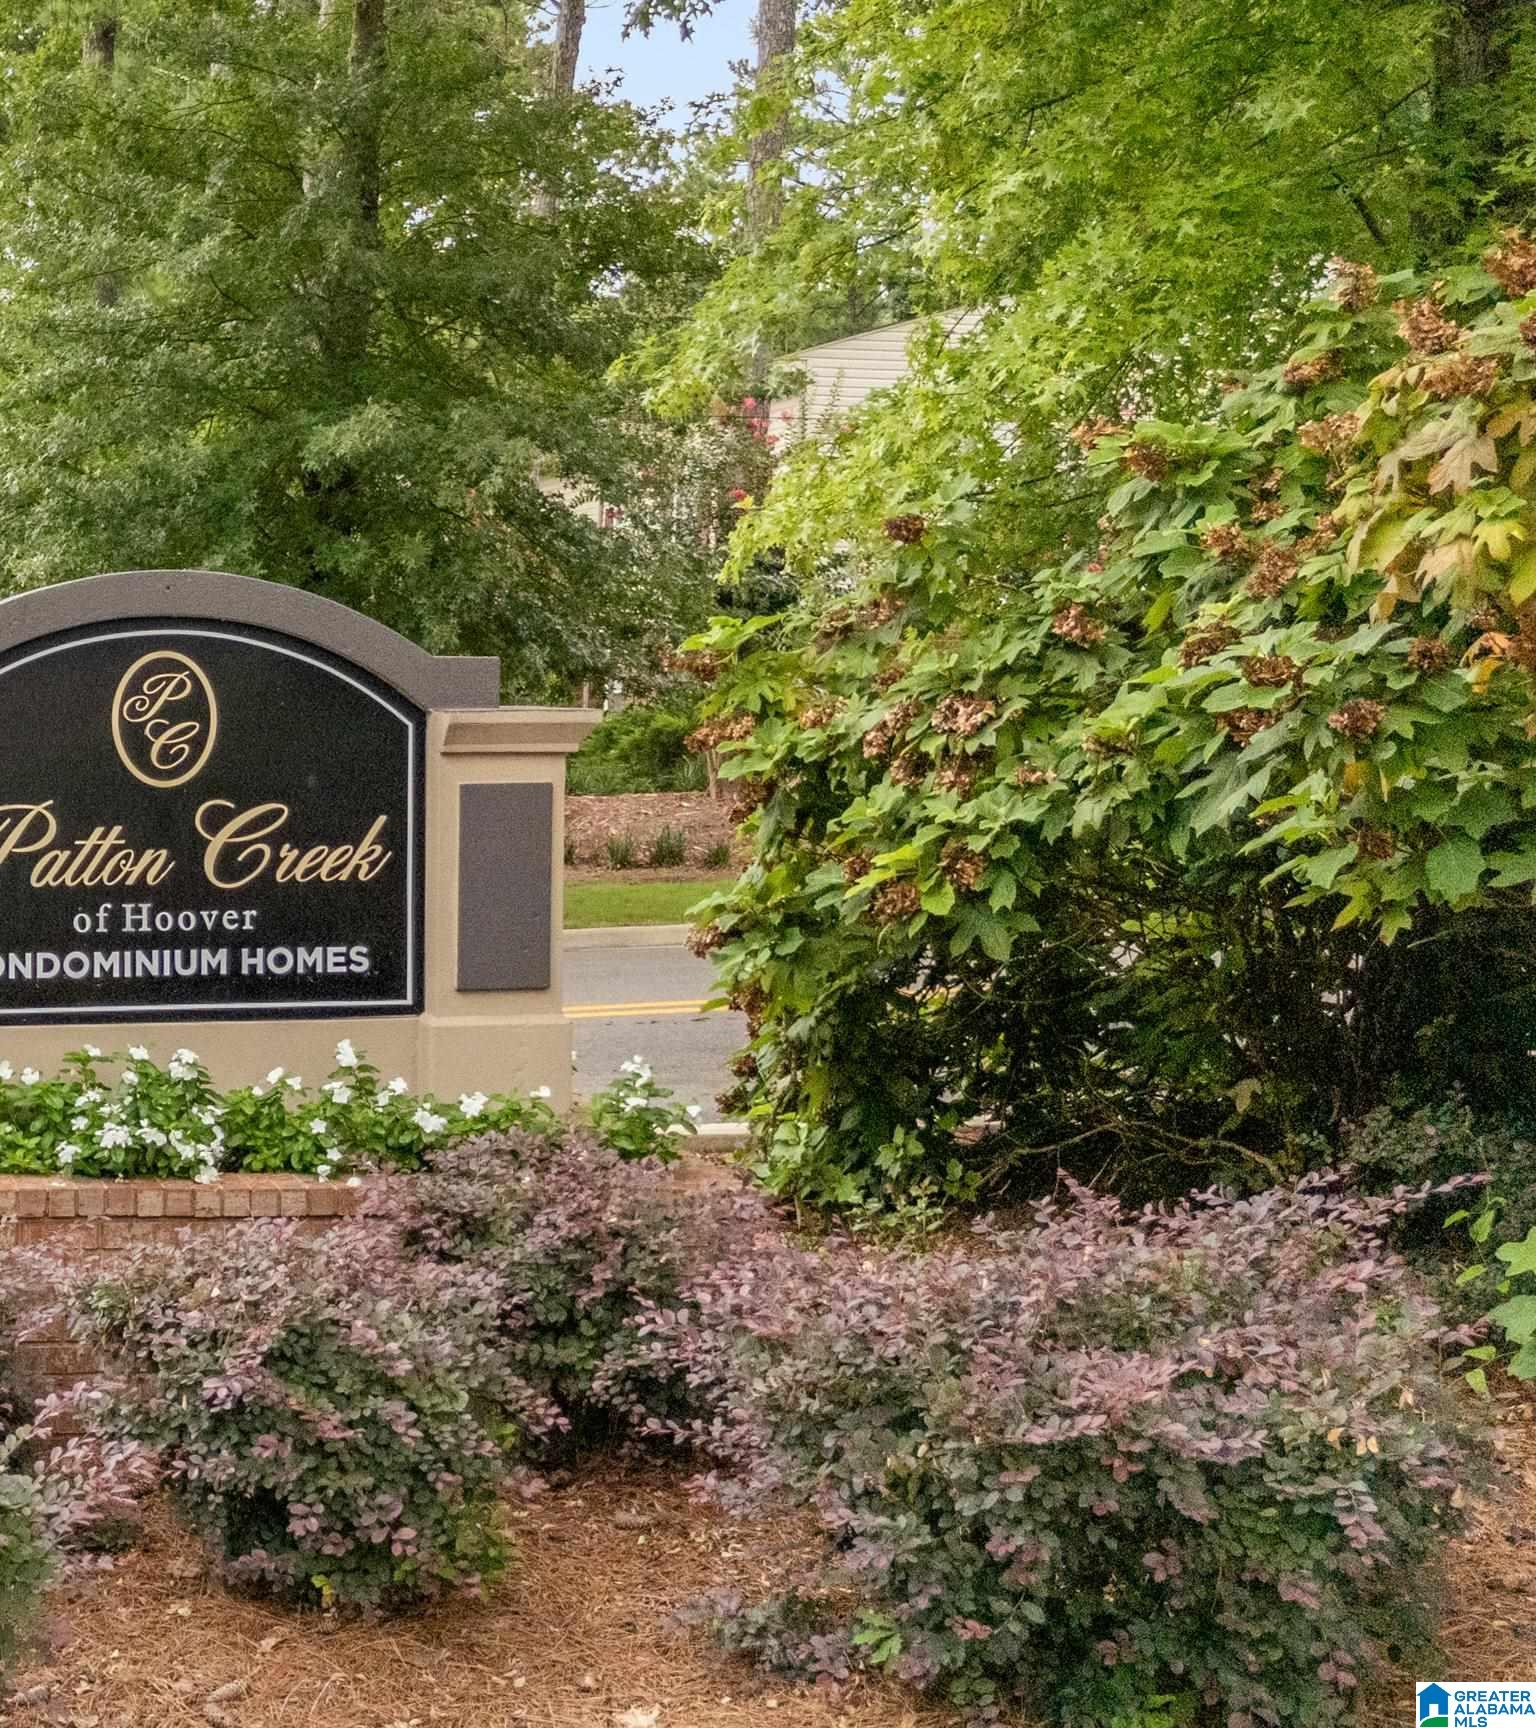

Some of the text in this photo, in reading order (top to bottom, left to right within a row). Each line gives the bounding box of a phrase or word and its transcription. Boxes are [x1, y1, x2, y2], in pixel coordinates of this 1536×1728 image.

[122, 670, 192, 721] P
[144, 719, 199, 769] C
[195, 799, 392, 889] Creek
[72, 903, 257, 933] of Hoover
[241, 946, 370, 975] HOMES
